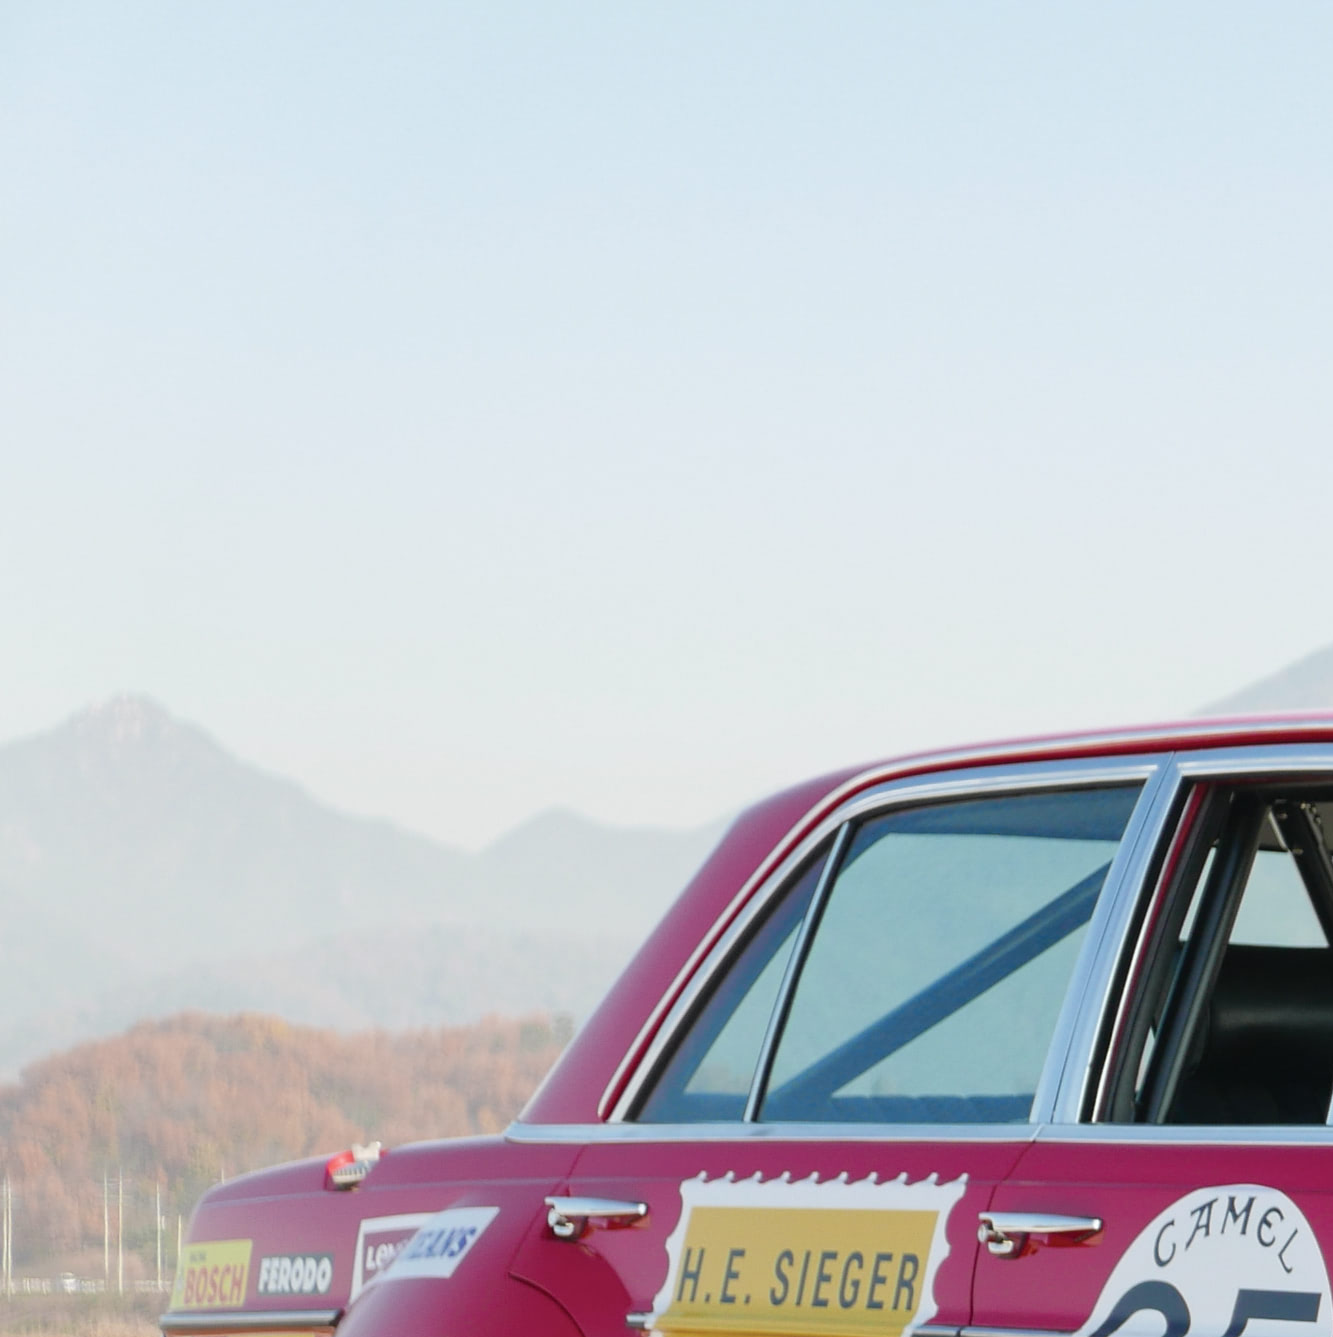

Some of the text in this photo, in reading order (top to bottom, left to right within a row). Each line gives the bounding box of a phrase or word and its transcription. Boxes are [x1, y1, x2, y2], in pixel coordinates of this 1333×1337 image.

[1153, 1196, 1300, 1274] CAMEL
[184, 1263, 246, 1305] BOSCH
[257, 1256, 333, 1294] FERODO
[676, 1247, 919, 1311] H.E. SIEGER
